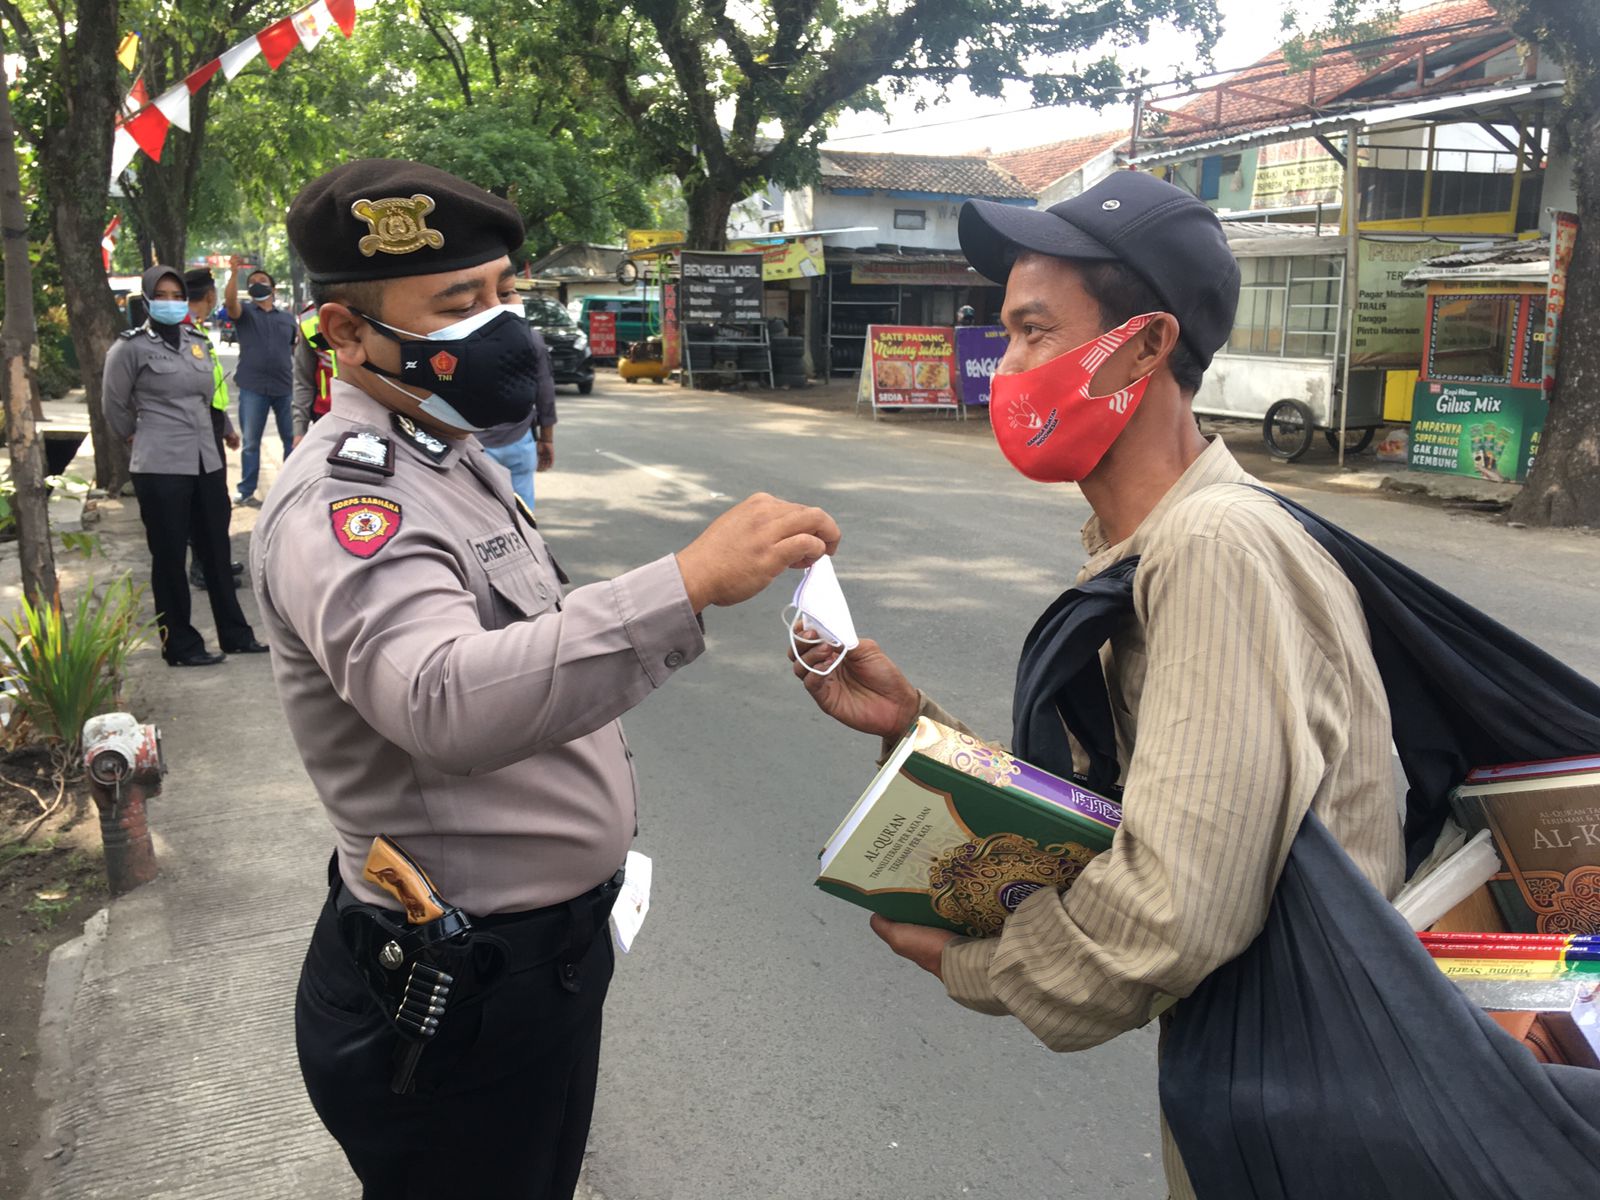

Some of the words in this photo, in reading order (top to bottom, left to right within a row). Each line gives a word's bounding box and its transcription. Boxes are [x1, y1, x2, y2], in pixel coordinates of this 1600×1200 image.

[683, 263, 729, 278] BENGKEL
[730, 265, 760, 278] MOBIL
[1358, 289, 1384, 299] Pagar
[1386, 290, 1425, 299] Minimalis
[1358, 302, 1387, 311] TRALIS
[1357, 315, 1387, 325] Tangga
[880, 332, 903, 342] SATE
[904, 333, 945, 342] PADANG
[1356, 327, 1380, 336] Pintu
[873, 339, 917, 361] Minang
[437, 374, 453, 382] TNI
[878, 393, 903, 402] SEDIA
[1435, 394, 1471, 414] Gilus
[1474, 396, 1502, 413] Mix
[1036, 418, 1059, 447] INDONESIA
[1415, 420, 1462, 435] AMPASNYA
[1415, 433, 1436, 444] SUPER
[1437, 435, 1459, 446] HALUS
[1413, 443, 1431, 455] GAK
[1433, 445, 1458, 458] BIKIN
[1412, 455, 1458, 469] KEMBUNG
[331, 497, 359, 511] KORPS
[864, 813, 907, 863] AL-QUR'AN
[869, 842, 902, 879] TRANSLITERASI
[899, 832, 911, 845] PER
[907, 820, 922, 834] KATA
[916, 806, 932, 821] DAN
[1532, 823, 1600, 850] AL-K
[888, 846, 914, 873] TERJEMAH
[909, 837, 922, 848] PER
[917, 824, 934, 839] KATA
[1447, 965, 1483, 976] Syarif
